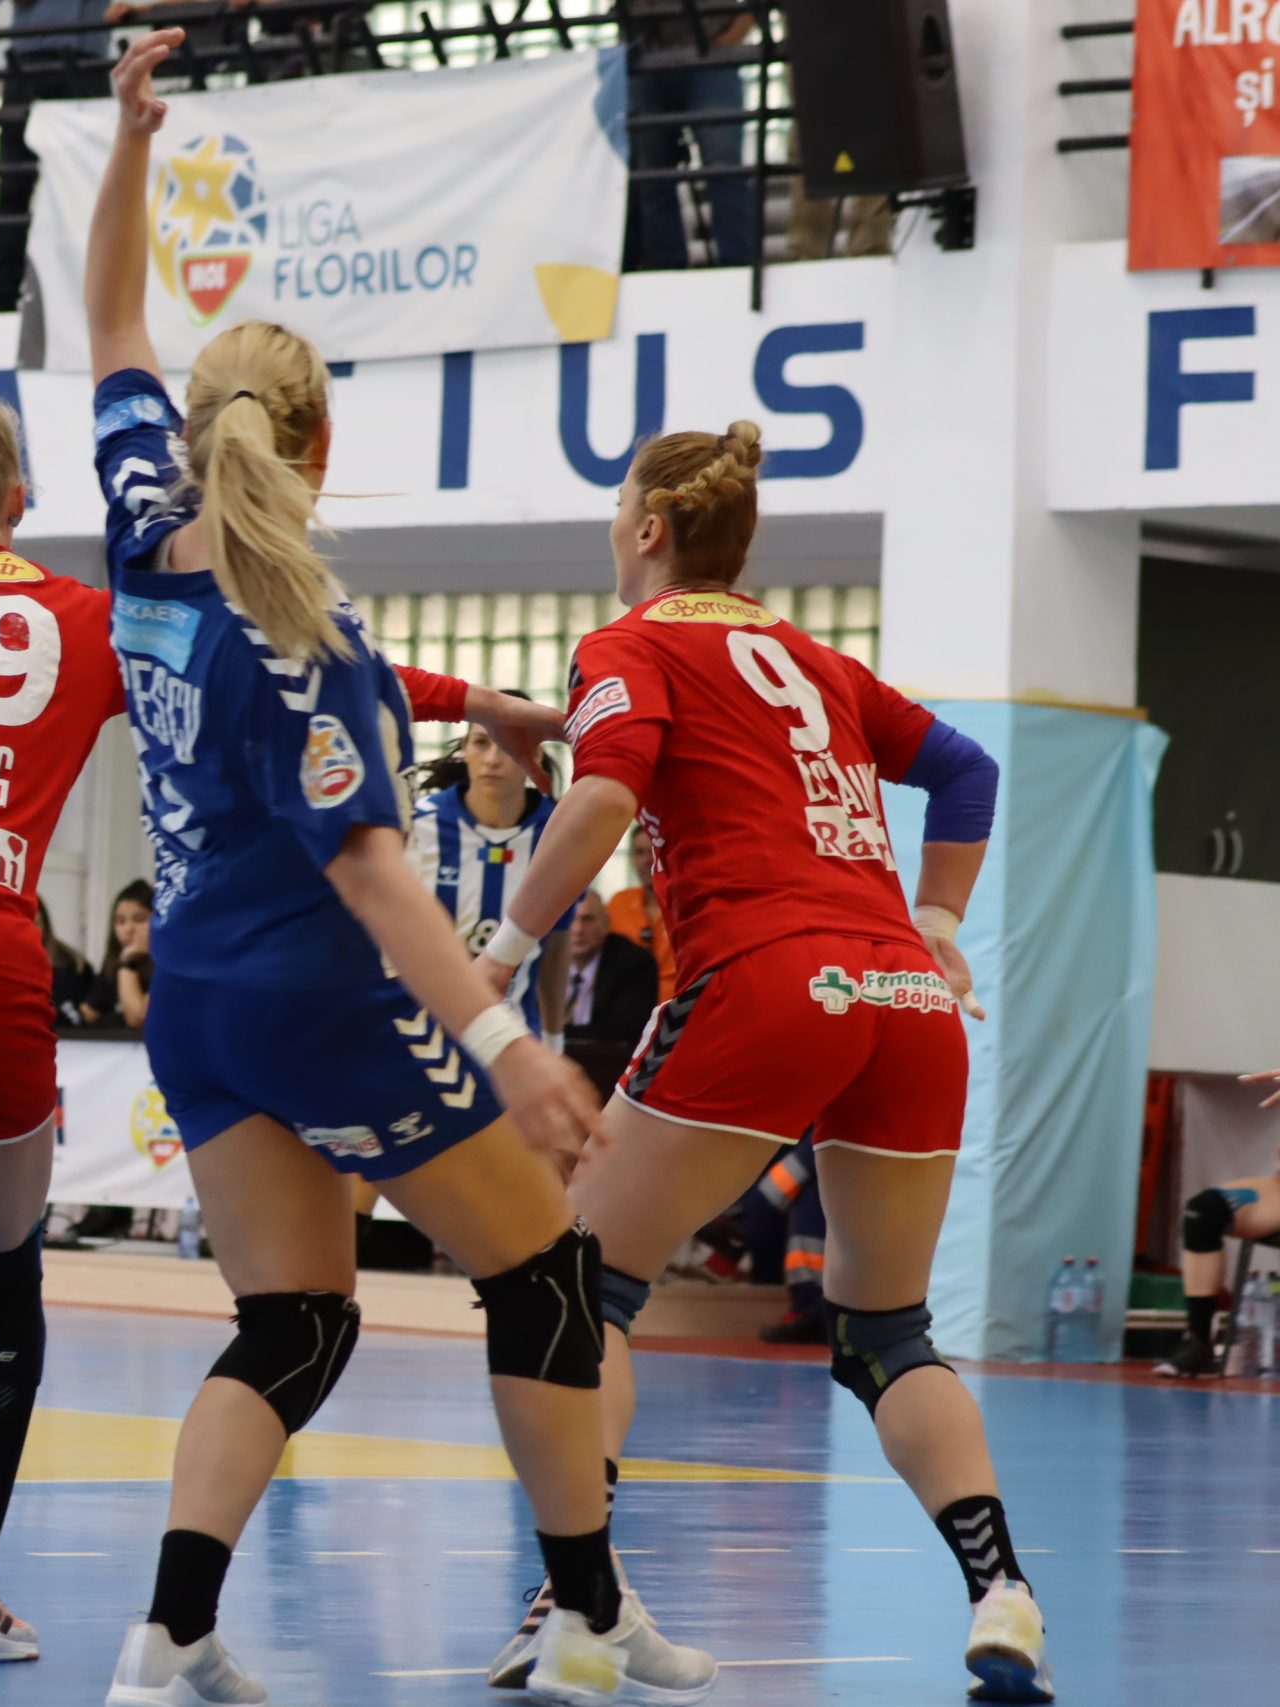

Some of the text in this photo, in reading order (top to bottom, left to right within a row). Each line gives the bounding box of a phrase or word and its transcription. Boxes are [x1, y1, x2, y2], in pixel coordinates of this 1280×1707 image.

[278, 201, 362, 249] LIGA
[273, 244, 479, 301] FLORILOR
[659, 599, 761, 620] Boromir
[726, 630, 830, 753] 9
